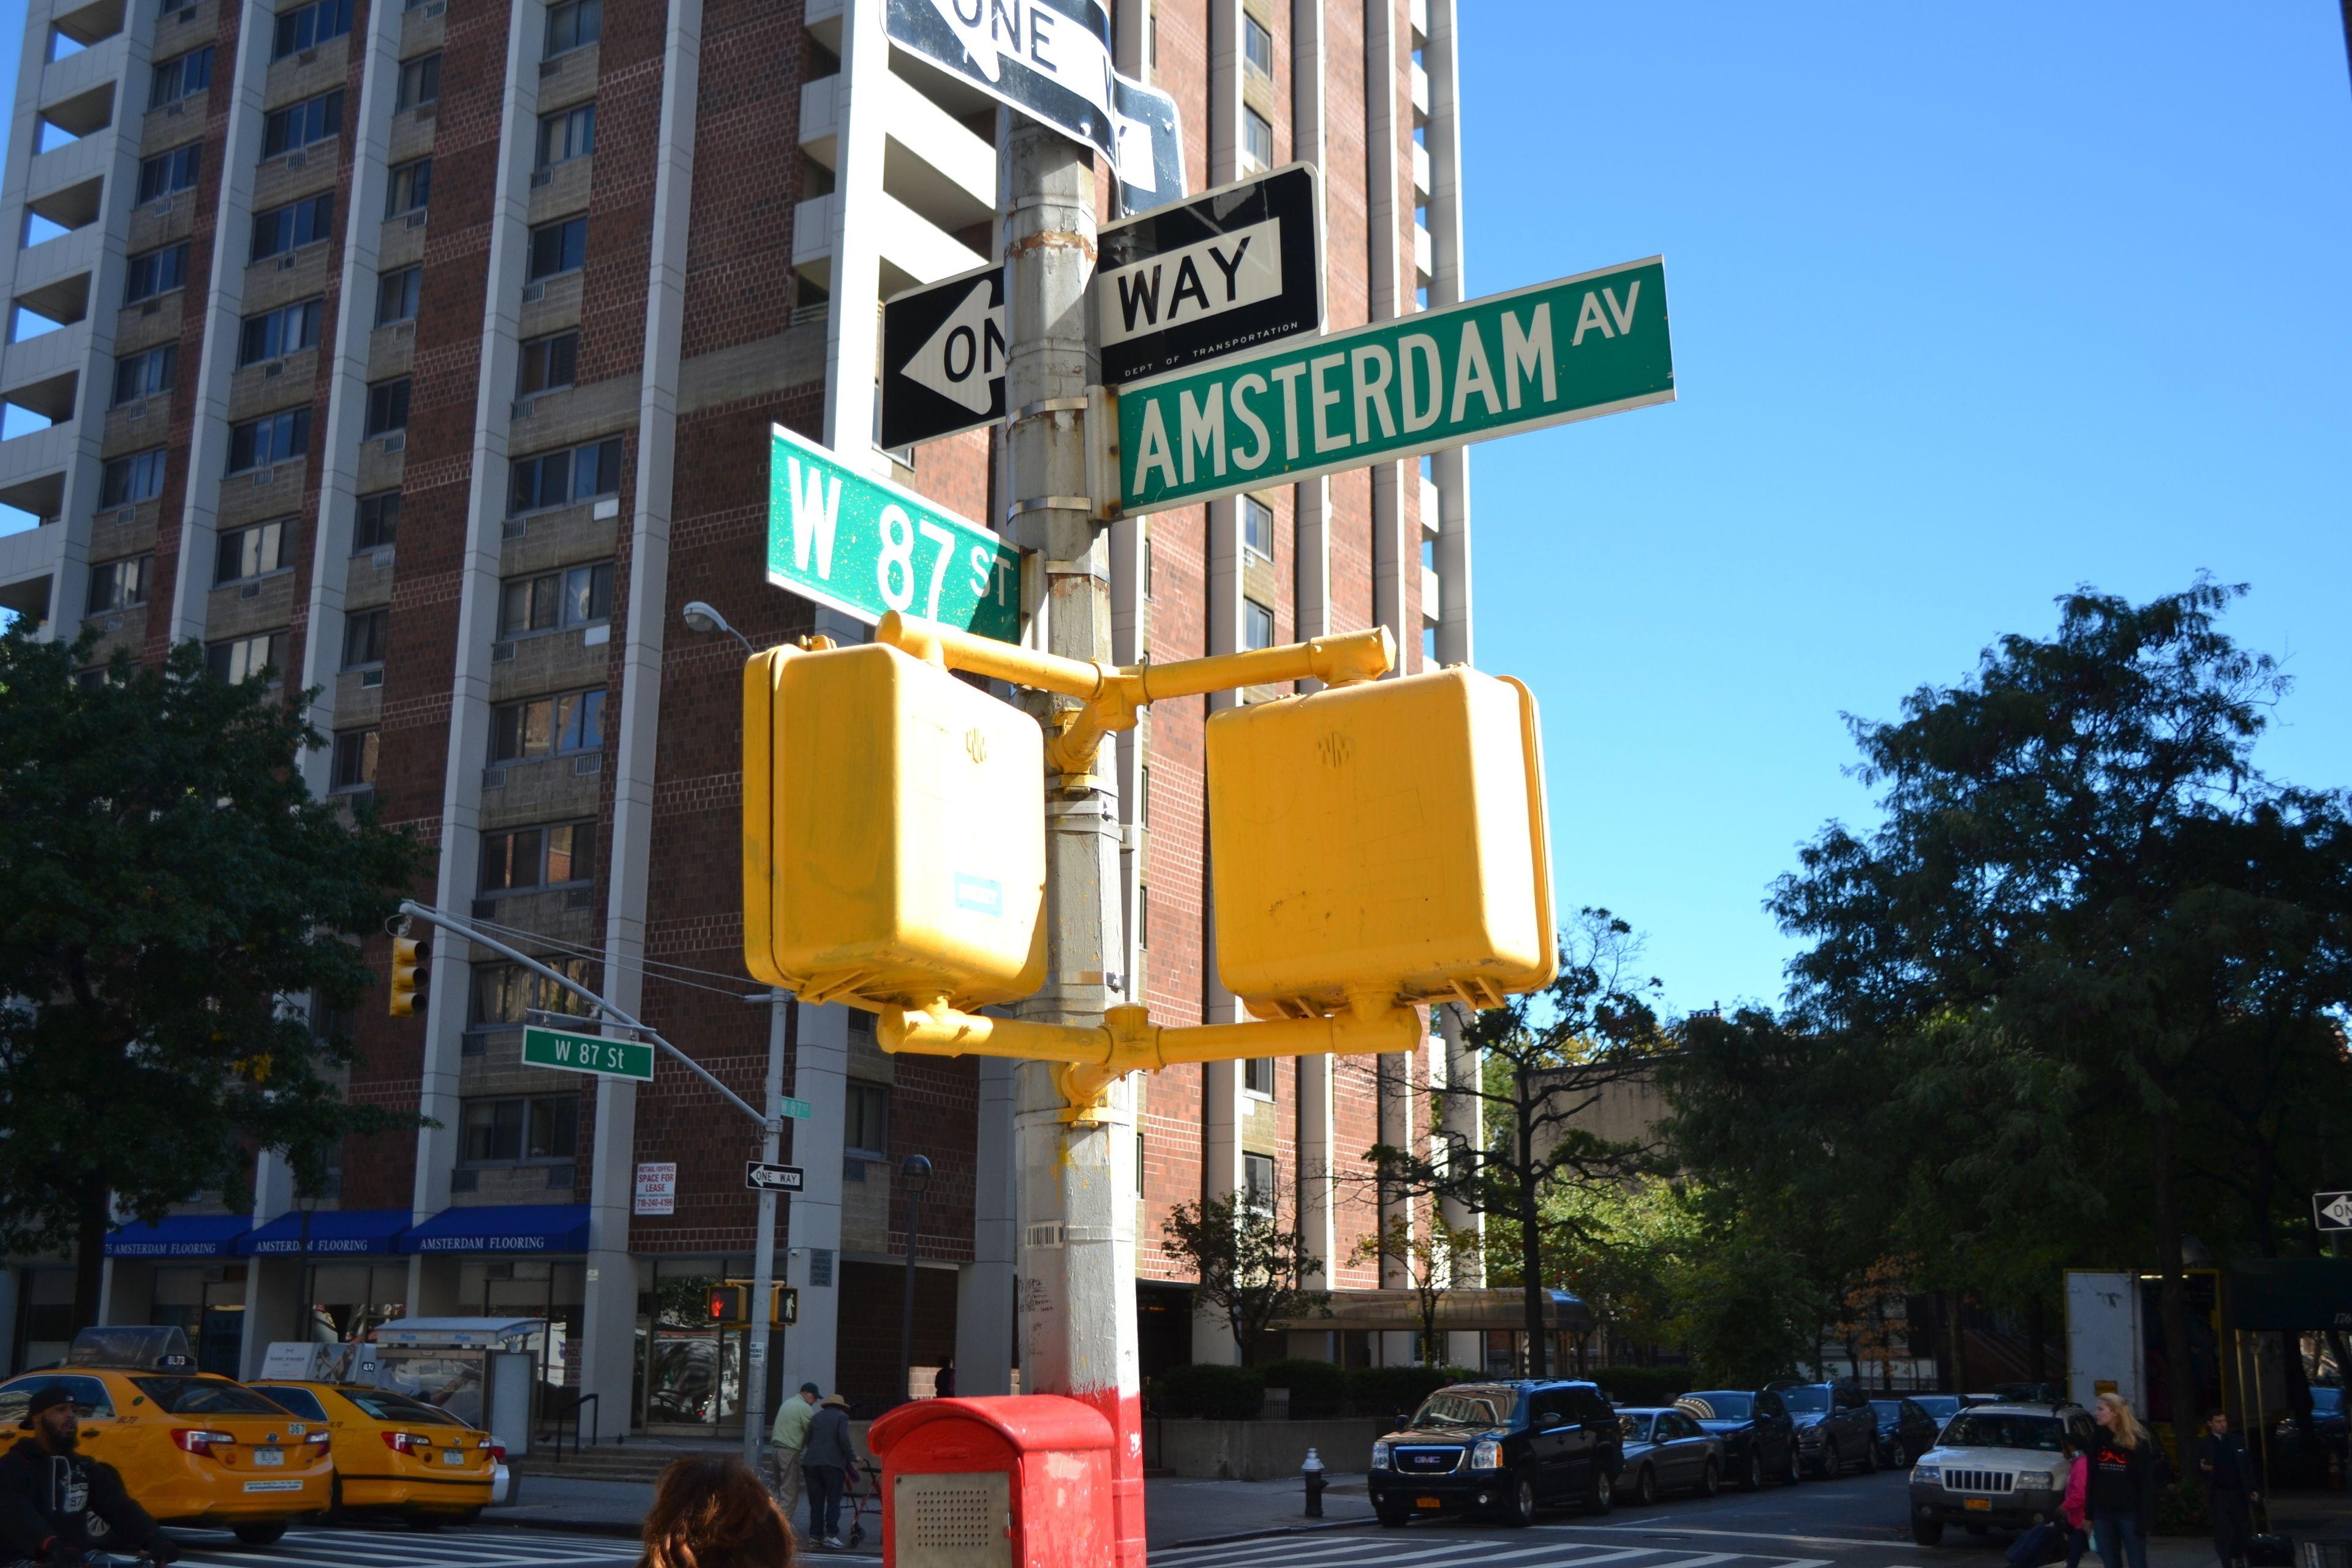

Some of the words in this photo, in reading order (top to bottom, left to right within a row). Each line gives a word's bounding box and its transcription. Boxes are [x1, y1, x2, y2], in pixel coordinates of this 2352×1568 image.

[954, 0, 1057, 74] ONE
[944, 318, 1005, 383] ON
[1118, 236, 1251, 332] WAY
[1125, 363, 1153, 377] DEPT
[1166, 356, 1180, 365] OF
[1193, 322, 1298, 357] TRANSPORTATION
[1133, 302, 1557, 497] AMSTERDAM
[1572, 281, 1640, 346] AV
[788, 456, 842, 581] W
[877, 503, 956, 622] 87
[970, 546, 1011, 606] ST
[555, 1039, 571, 1061] W
[579, 1043, 600, 1066] 87
[608, 1047, 624, 1069] St
[662, 1174, 674, 1182] FOR
[756, 1171, 772, 1182] ONE
[780, 1174, 796, 1184] WAY
[646, 1183, 666, 1192] LEASE
[2334, 1204, 2352, 1218] ON
[114, 1243, 167, 1254] AMSTERDAM
[170, 1243, 216, 1254] FLOORING
[255, 1240, 314, 1252] AMSTERDM
[318, 1240, 368, 1251] FLOORING
[420, 1237, 484, 1250] AMSTERDAM
[489, 1236, 545, 1249] FLOORING
